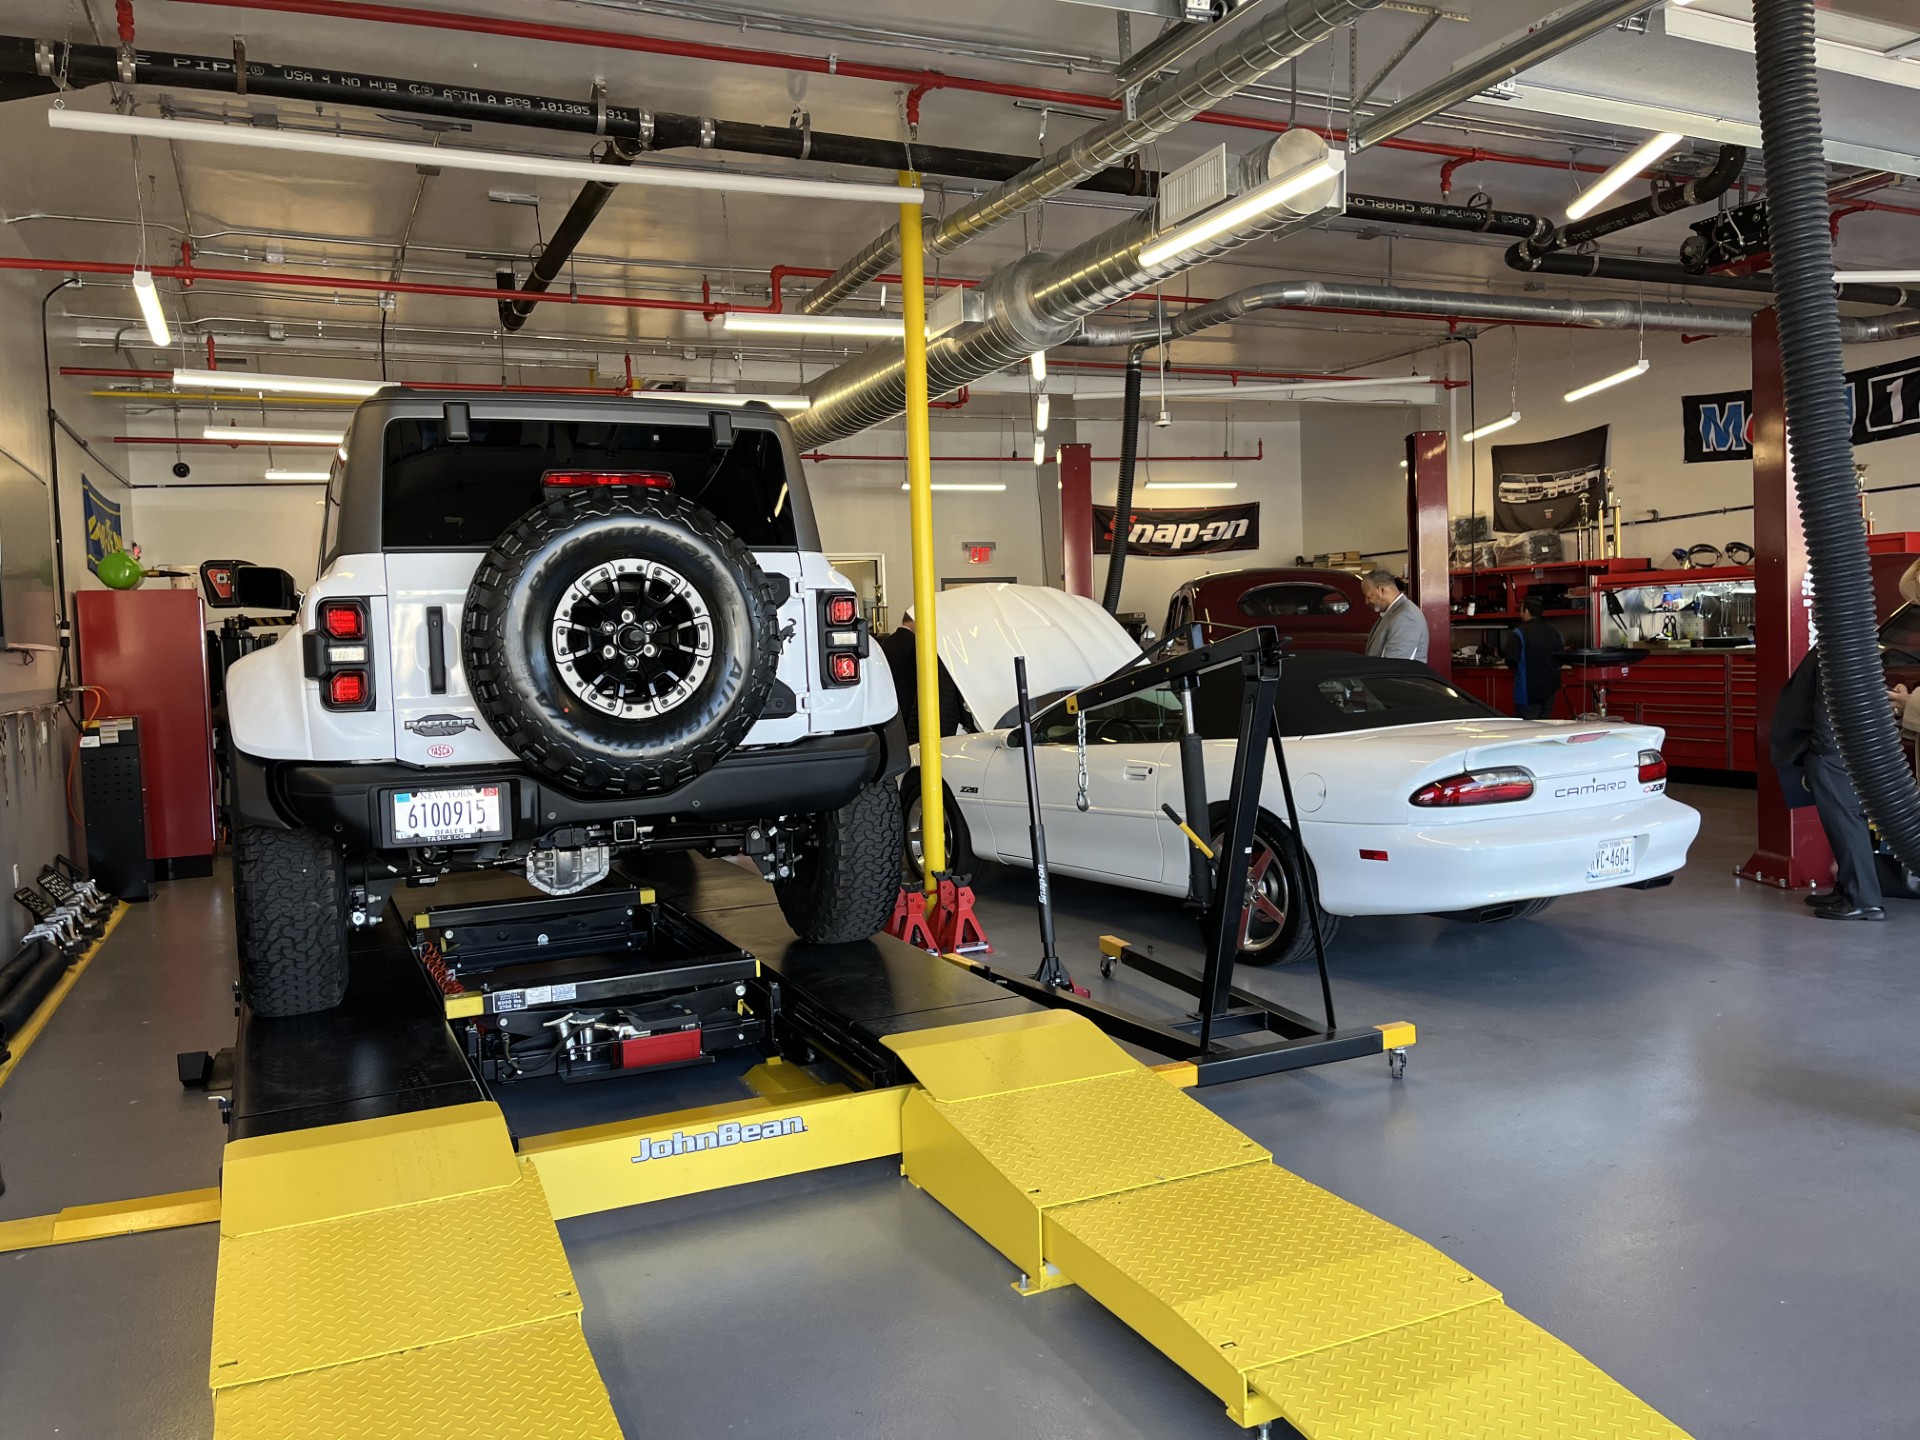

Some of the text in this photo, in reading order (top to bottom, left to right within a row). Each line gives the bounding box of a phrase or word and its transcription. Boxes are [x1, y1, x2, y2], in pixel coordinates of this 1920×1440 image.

[284, 69, 313, 83] USA
[341, 77, 361, 88] NO
[369, 79, 398, 93] HUB
[443, 88, 480, 104] ASTM
[487, 95, 497, 105] A
[540, 101, 590, 116] 101305
[607, 108, 630, 122] 911
[1347, 197, 1415, 213] CHARLOT
[1420, 206, 1436, 215] USA
[971, 546, 991, 562] EXIT
[404, 718, 481, 733] RAPTOR
[430, 744, 451, 757] TASCA
[420, 790, 443, 801] NEW
[447, 788, 475, 799] YORK
[1554, 781, 1627, 798] CAMARO
[408, 799, 487, 829] 6100915
[427, 833, 471, 842] TASCA.COM
[434, 827, 464, 836] DEALER
